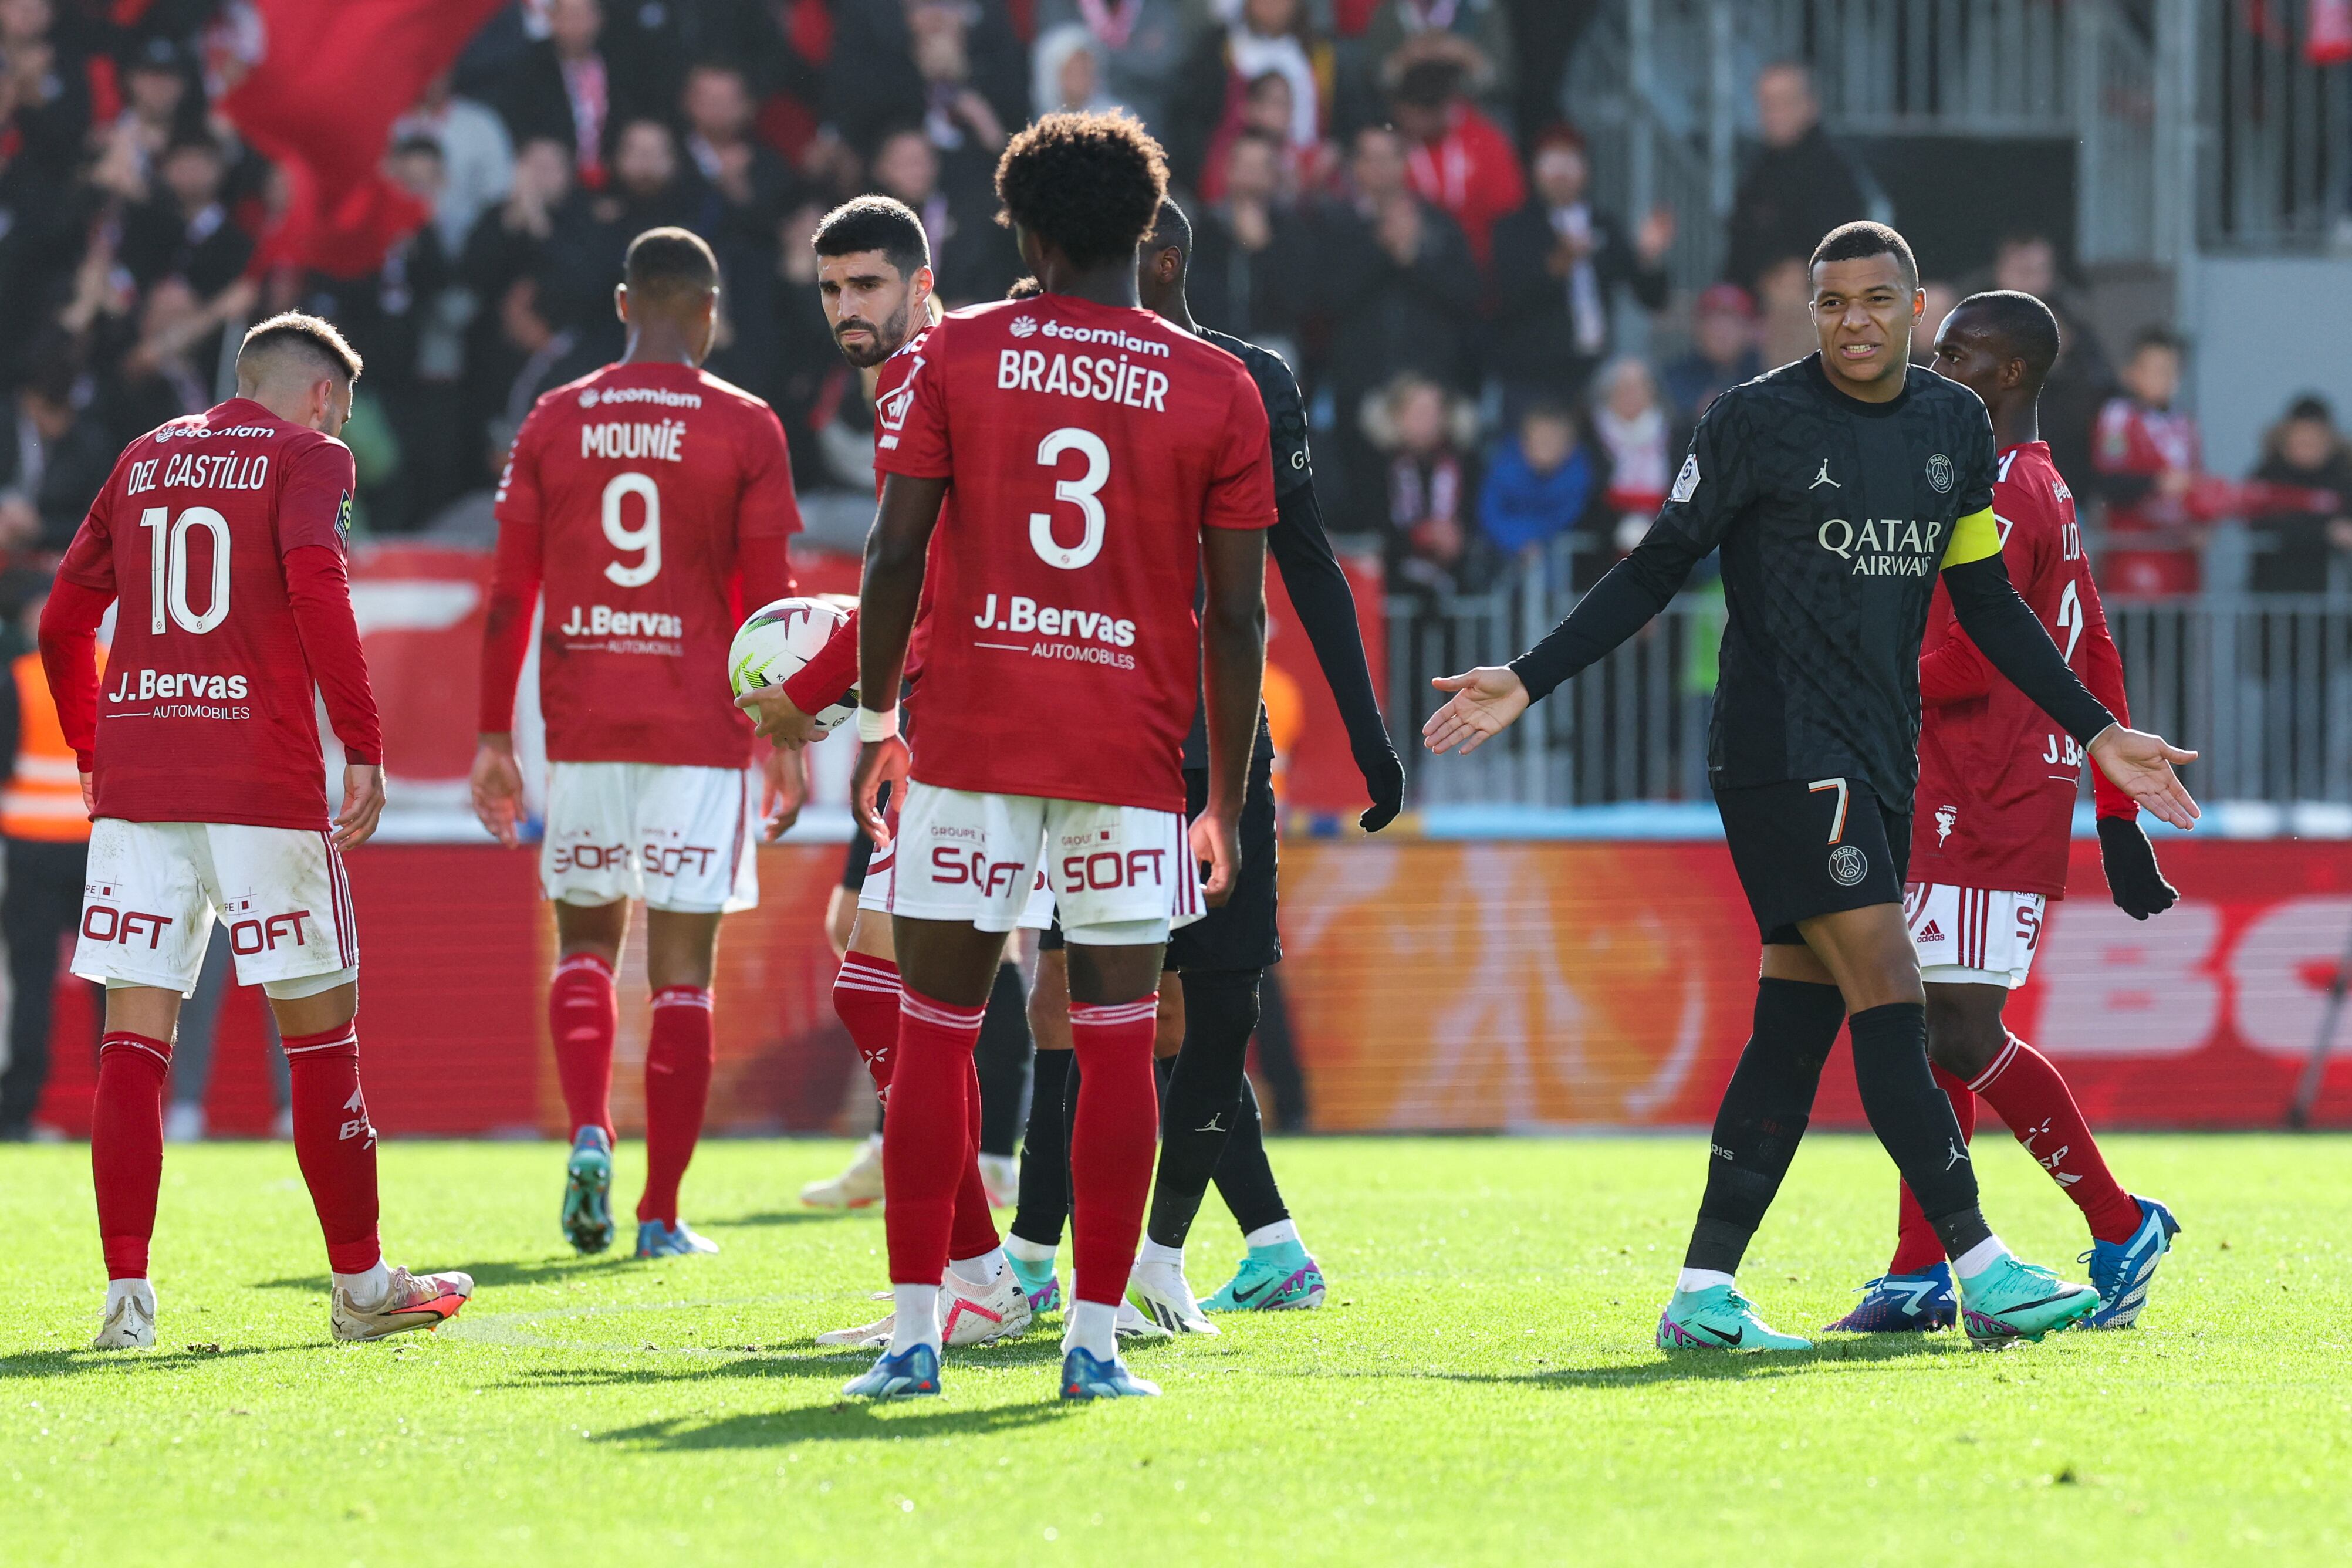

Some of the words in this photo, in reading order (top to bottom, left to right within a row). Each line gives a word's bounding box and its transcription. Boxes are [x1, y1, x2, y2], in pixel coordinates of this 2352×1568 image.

[1042, 320, 1170, 359] écomiam
[601, 387, 701, 409] écomiam
[127, 458, 159, 496] DEL
[1930, 456, 1948, 466] PARIS
[1029, 427, 1110, 569] 3
[601, 472, 661, 587] 9
[1818, 519, 1941, 560] QATAR
[140, 506, 231, 635] 10
[974, 594, 1136, 647] J.Bervas
[109, 669, 248, 702] J.Bervas
[153, 705, 250, 720] AUTOMOBILES
[1808, 778, 1848, 844] 7
[1063, 849, 1165, 893] SOFT
[1833, 848, 1857, 860] PARIS
[83, 905, 173, 949] OFT
[231, 910, 310, 955] OFT
[1917, 934, 1945, 943] adidas
[339, 1113, 367, 1140] BS
[1711, 1144, 1735, 1160] RIS
[2038, 1145, 2069, 1170] SP
